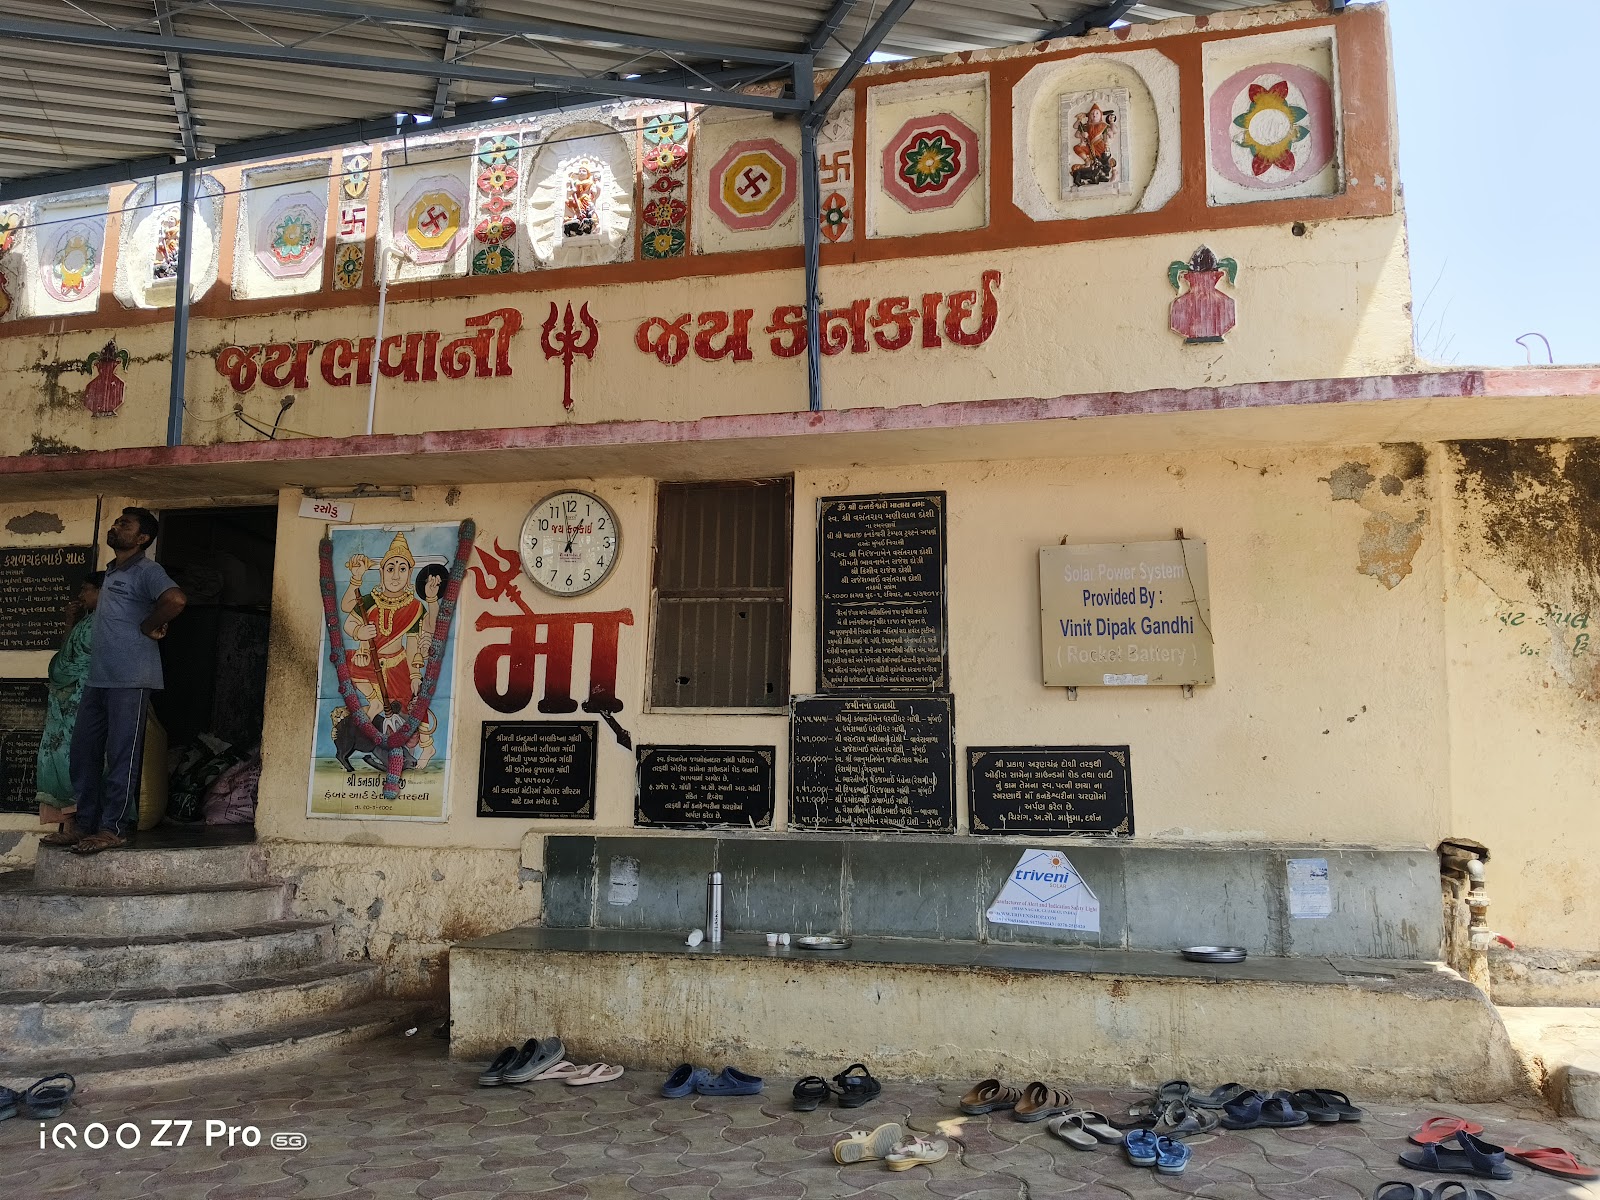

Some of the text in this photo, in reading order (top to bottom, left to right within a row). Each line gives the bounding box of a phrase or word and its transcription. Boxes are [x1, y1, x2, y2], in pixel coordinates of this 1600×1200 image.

[635, 269, 1002, 365] જય કનકાઈ
[550, 506, 559, 518] 11
[566, 500, 577, 512] 12
[842, 513, 851, 522] શ્રી
[918, 510, 935, 519] દોશી
[538, 519, 549, 531] 10
[598, 518, 605, 530] 2
[532, 538, 538, 549] 9
[602, 536, 610, 549] 3
[66, 552, 86, 565] શાહ
[536, 556, 543, 568] 8
[597, 556, 604, 567] 4
[551, 570, 558, 582] 7
[583, 569, 591, 581] 5
[1064, 562, 1184, 584] Solar Power System
[566, 574, 573, 586] 6
[1083, 587, 1136, 606] Provided
[1060, 616, 1194, 640] Vinit Dipak Gandhi
[496, 734, 514, 743] શ્રીમતી
[568, 733, 582, 743] ગાંધી
[562, 744, 576, 753] ગાંધી
[503, 754, 522, 763] શ્રીમતી
[559, 754, 573, 763] ગાંધી
[995, 759, 1004, 768] શ્રી
[1006, 760, 1025, 769] પ્રકાશ
[1060, 759, 1077, 768] દોશી
[1080, 759, 1102, 769] તરફથી
[505, 764, 513, 773] શ્રી
[556, 764, 570, 773] ગાંધી
[984, 770, 1007, 779] ઓફીસ
[1010, 770, 1032, 779] સામેના
[1068, 770, 1079, 779] શેડ
[346, 774, 381, 787] શ્રી કનકાઈ
[1019, 780, 1038, 789] તેમના
[1055, 780, 1073, 789] પત્ની
[492, 785, 500, 794] શ્રી
[1078, 792, 1107, 801] ચરણોમાં
[1024, 802, 1075, 811] અર્પણ કરેલ છે.
[1085, 813, 1102, 822] દર્શન
[1016, 870, 1070, 884] triveni
